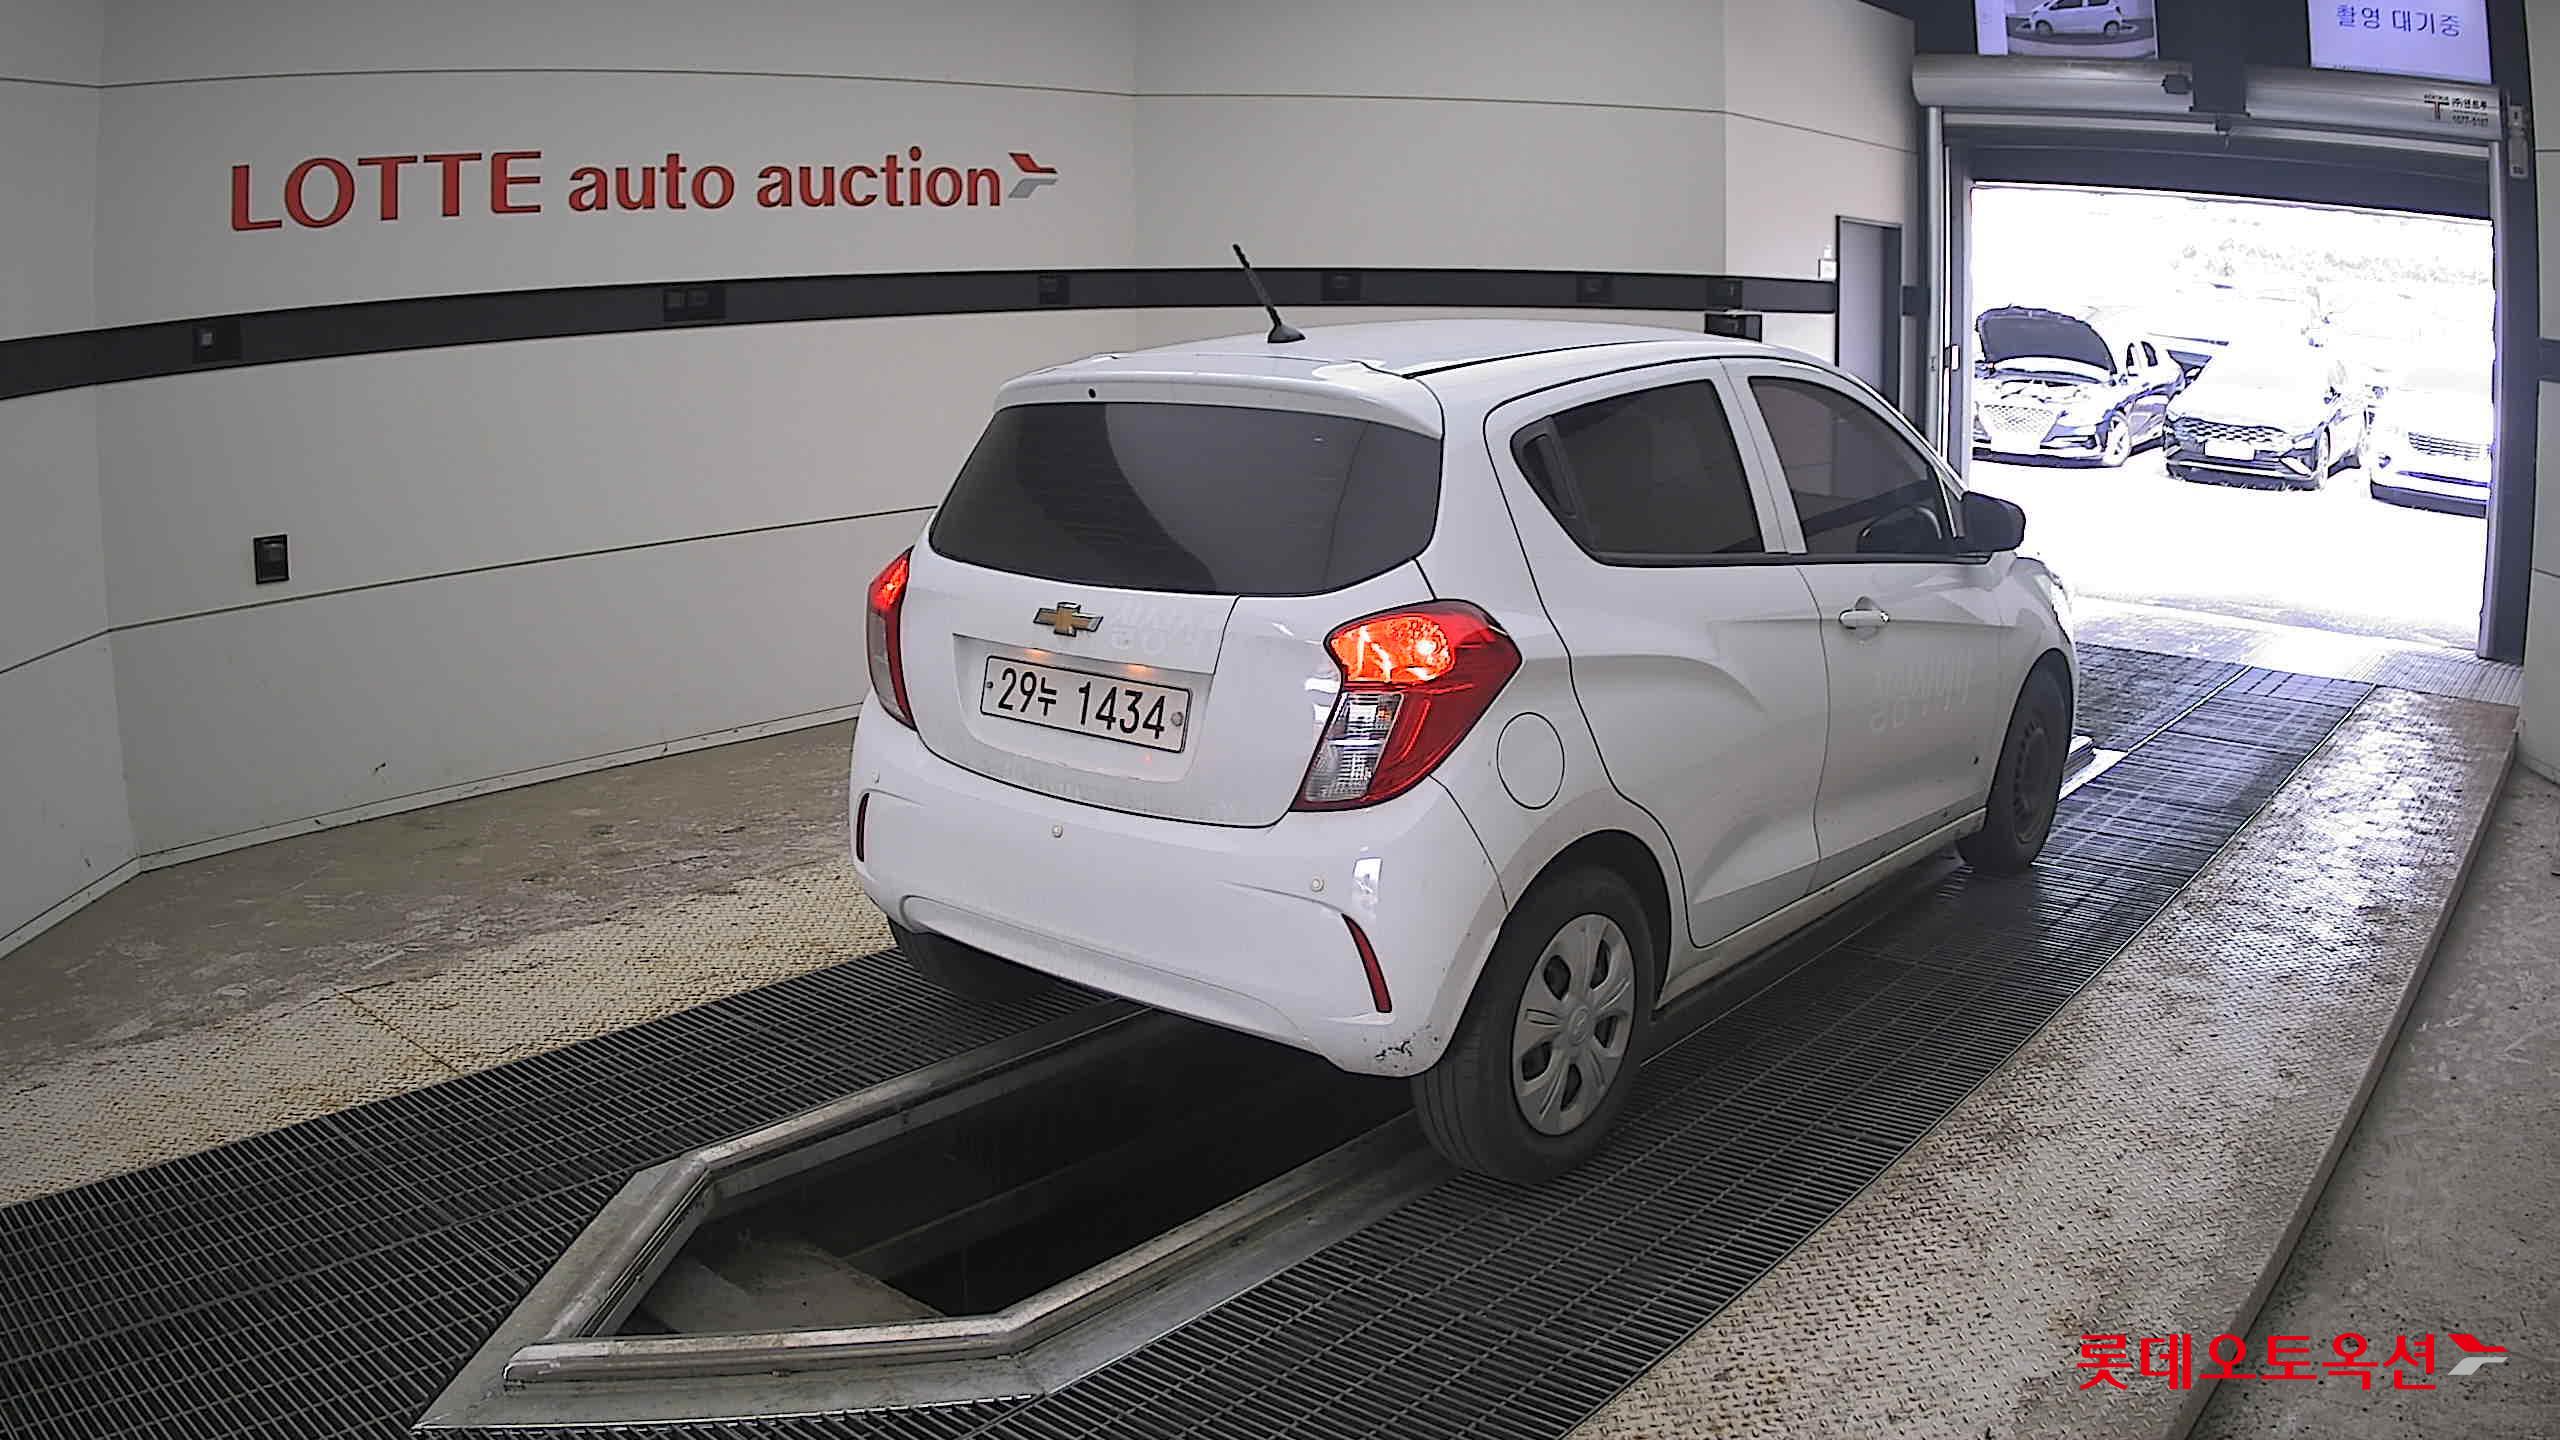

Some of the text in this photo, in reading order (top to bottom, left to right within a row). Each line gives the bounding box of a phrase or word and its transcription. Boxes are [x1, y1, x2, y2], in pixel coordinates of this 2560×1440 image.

[2337, 4, 2462, 38] 촬영 대기중
[231, 145, 1001, 232] LOTTE auto auction
[998, 667, 1167, 740] 29누 1434
